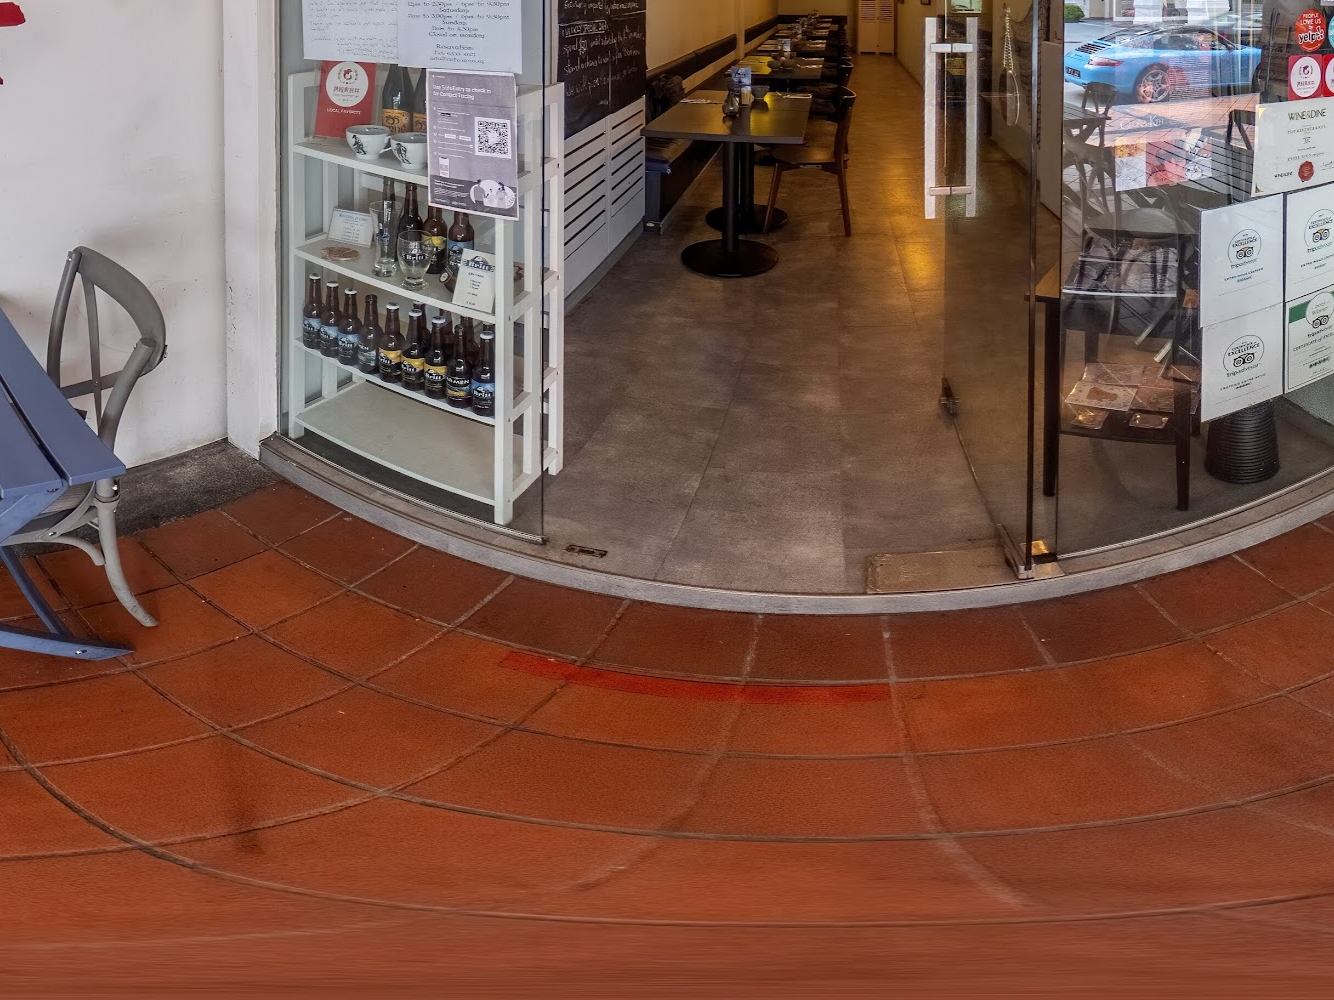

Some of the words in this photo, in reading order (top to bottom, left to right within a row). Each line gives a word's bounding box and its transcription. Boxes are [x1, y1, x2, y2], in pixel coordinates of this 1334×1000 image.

[1299, 31, 1316, 44] yelp
[1232, 238, 1257, 248] EXCELLENCE
[1307, 324, 1333, 338] tripadvisor
[1228, 343, 1260, 357] EXCELLENCE
